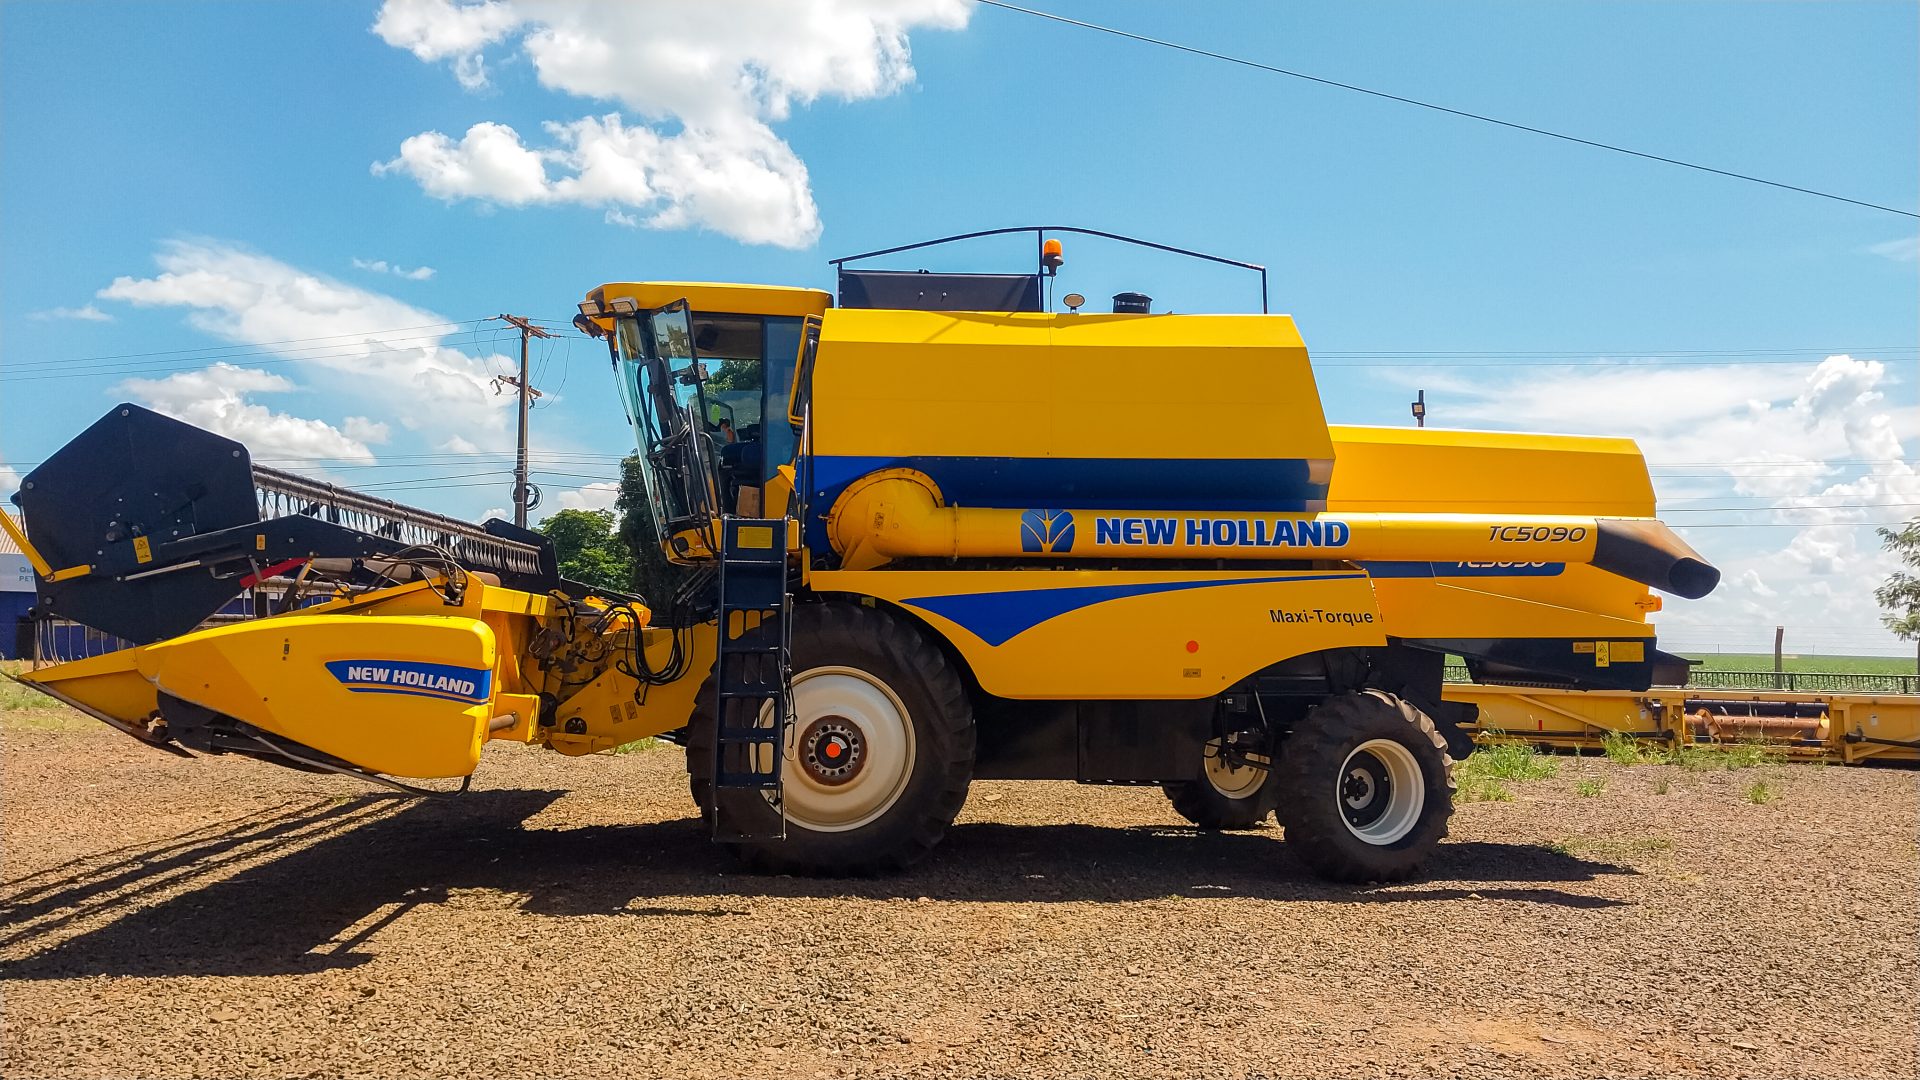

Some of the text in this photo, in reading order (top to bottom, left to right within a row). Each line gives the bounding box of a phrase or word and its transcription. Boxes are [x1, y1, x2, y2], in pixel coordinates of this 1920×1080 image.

[1095, 517, 1350, 548] NEW HOLLAND
[1489, 526, 1587, 543] TC5090
[1269, 609, 1374, 626] Maxi-Torque
[348, 666, 475, 696] NEW HOLLAND
